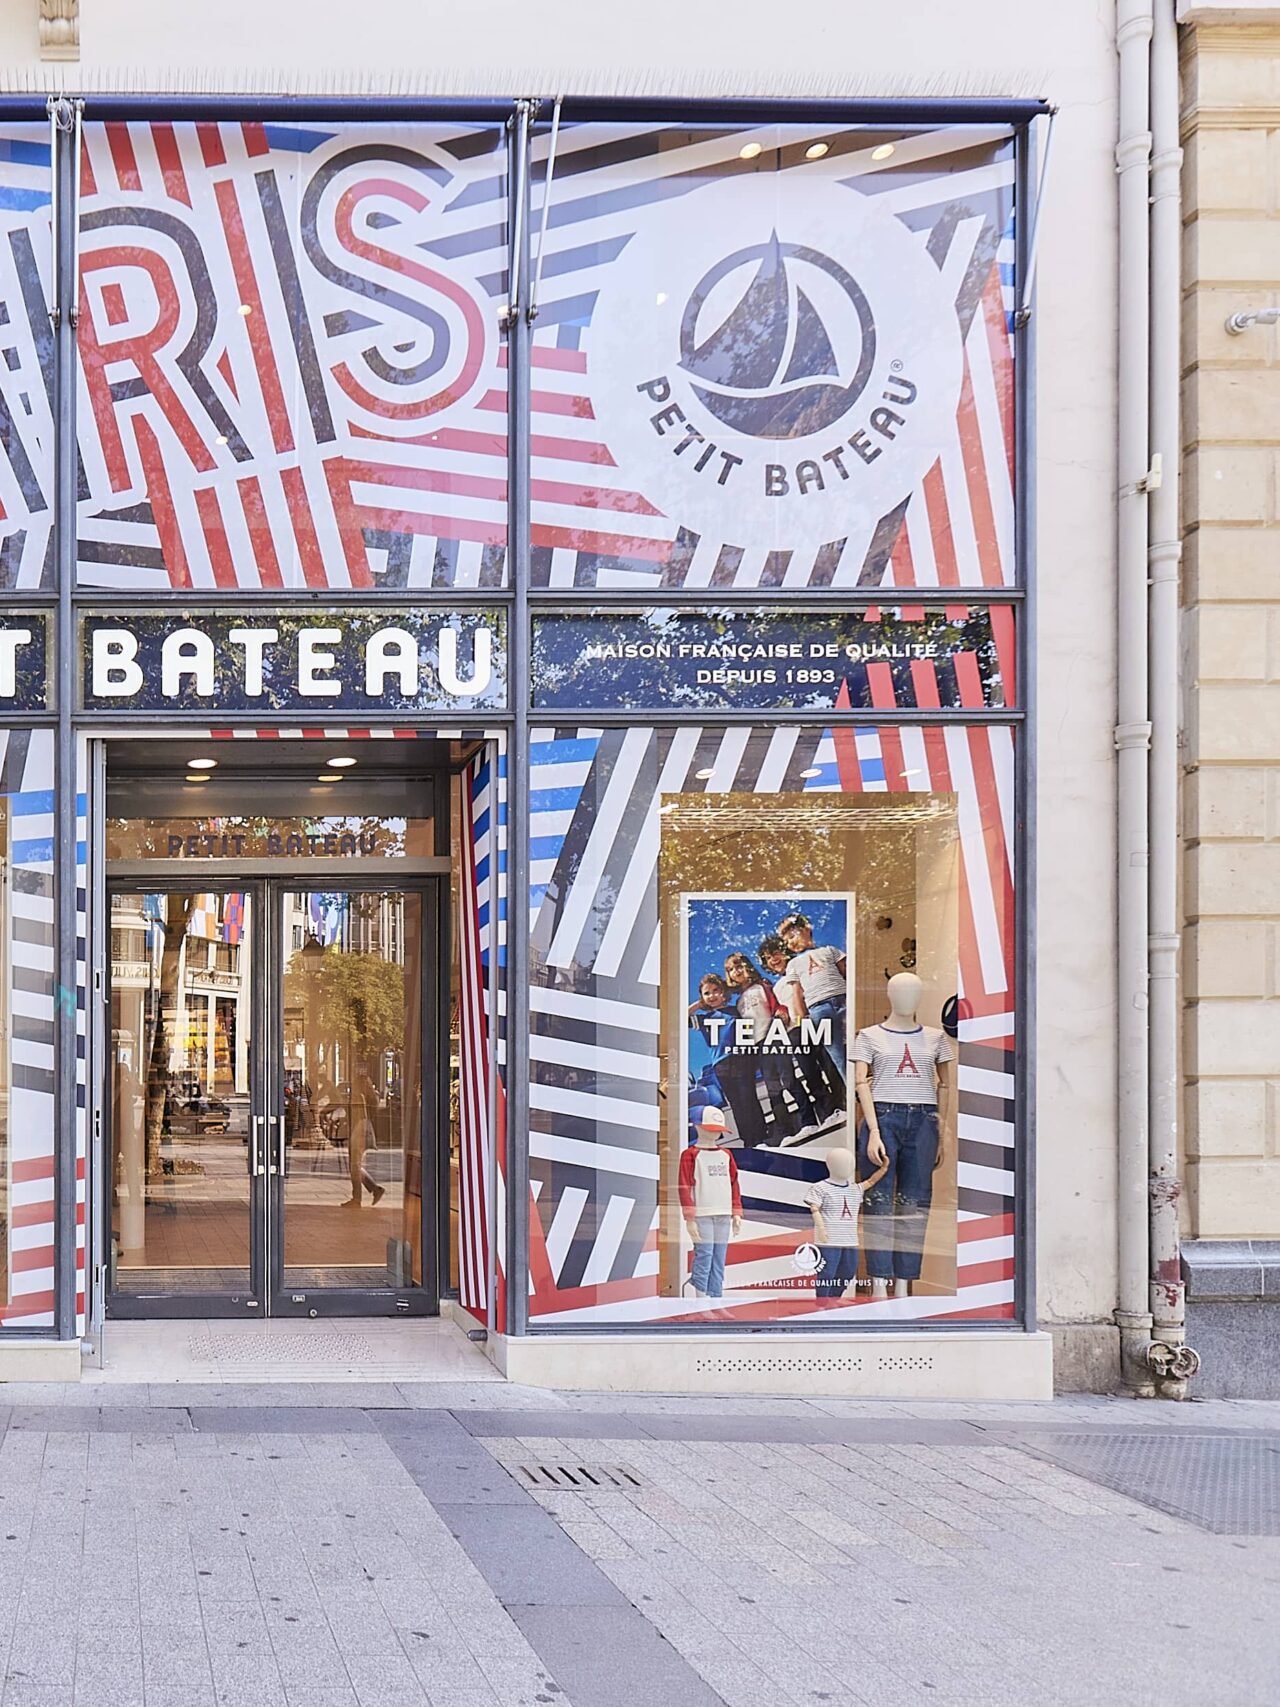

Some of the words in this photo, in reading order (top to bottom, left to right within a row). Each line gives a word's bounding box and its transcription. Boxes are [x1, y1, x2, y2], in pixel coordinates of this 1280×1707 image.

[636, 375, 744, 486] PETIT
[764, 374, 919, 497] BATEAU
[92, 626, 493, 699] BATEAU
[586, 643, 673, 659] MAISON
[678, 643, 802, 663] FRANÇAISE
[809, 644, 840, 658] DE
[845, 640, 939, 659] QUALITÉ
[696, 668, 777, 684] DEPUIS
[785, 669, 836, 684] 1893
[168, 834, 246, 856] PETIT
[268, 834, 377, 856] BATEAU
[703, 1018, 833, 1046] TEAM
[724, 1046, 760, 1055] PETIT
[762, 1046, 811, 1055] BATEAU
[798, 1279, 807, 1288] DE
[809, 1277, 842, 1288] QUALITÉ
